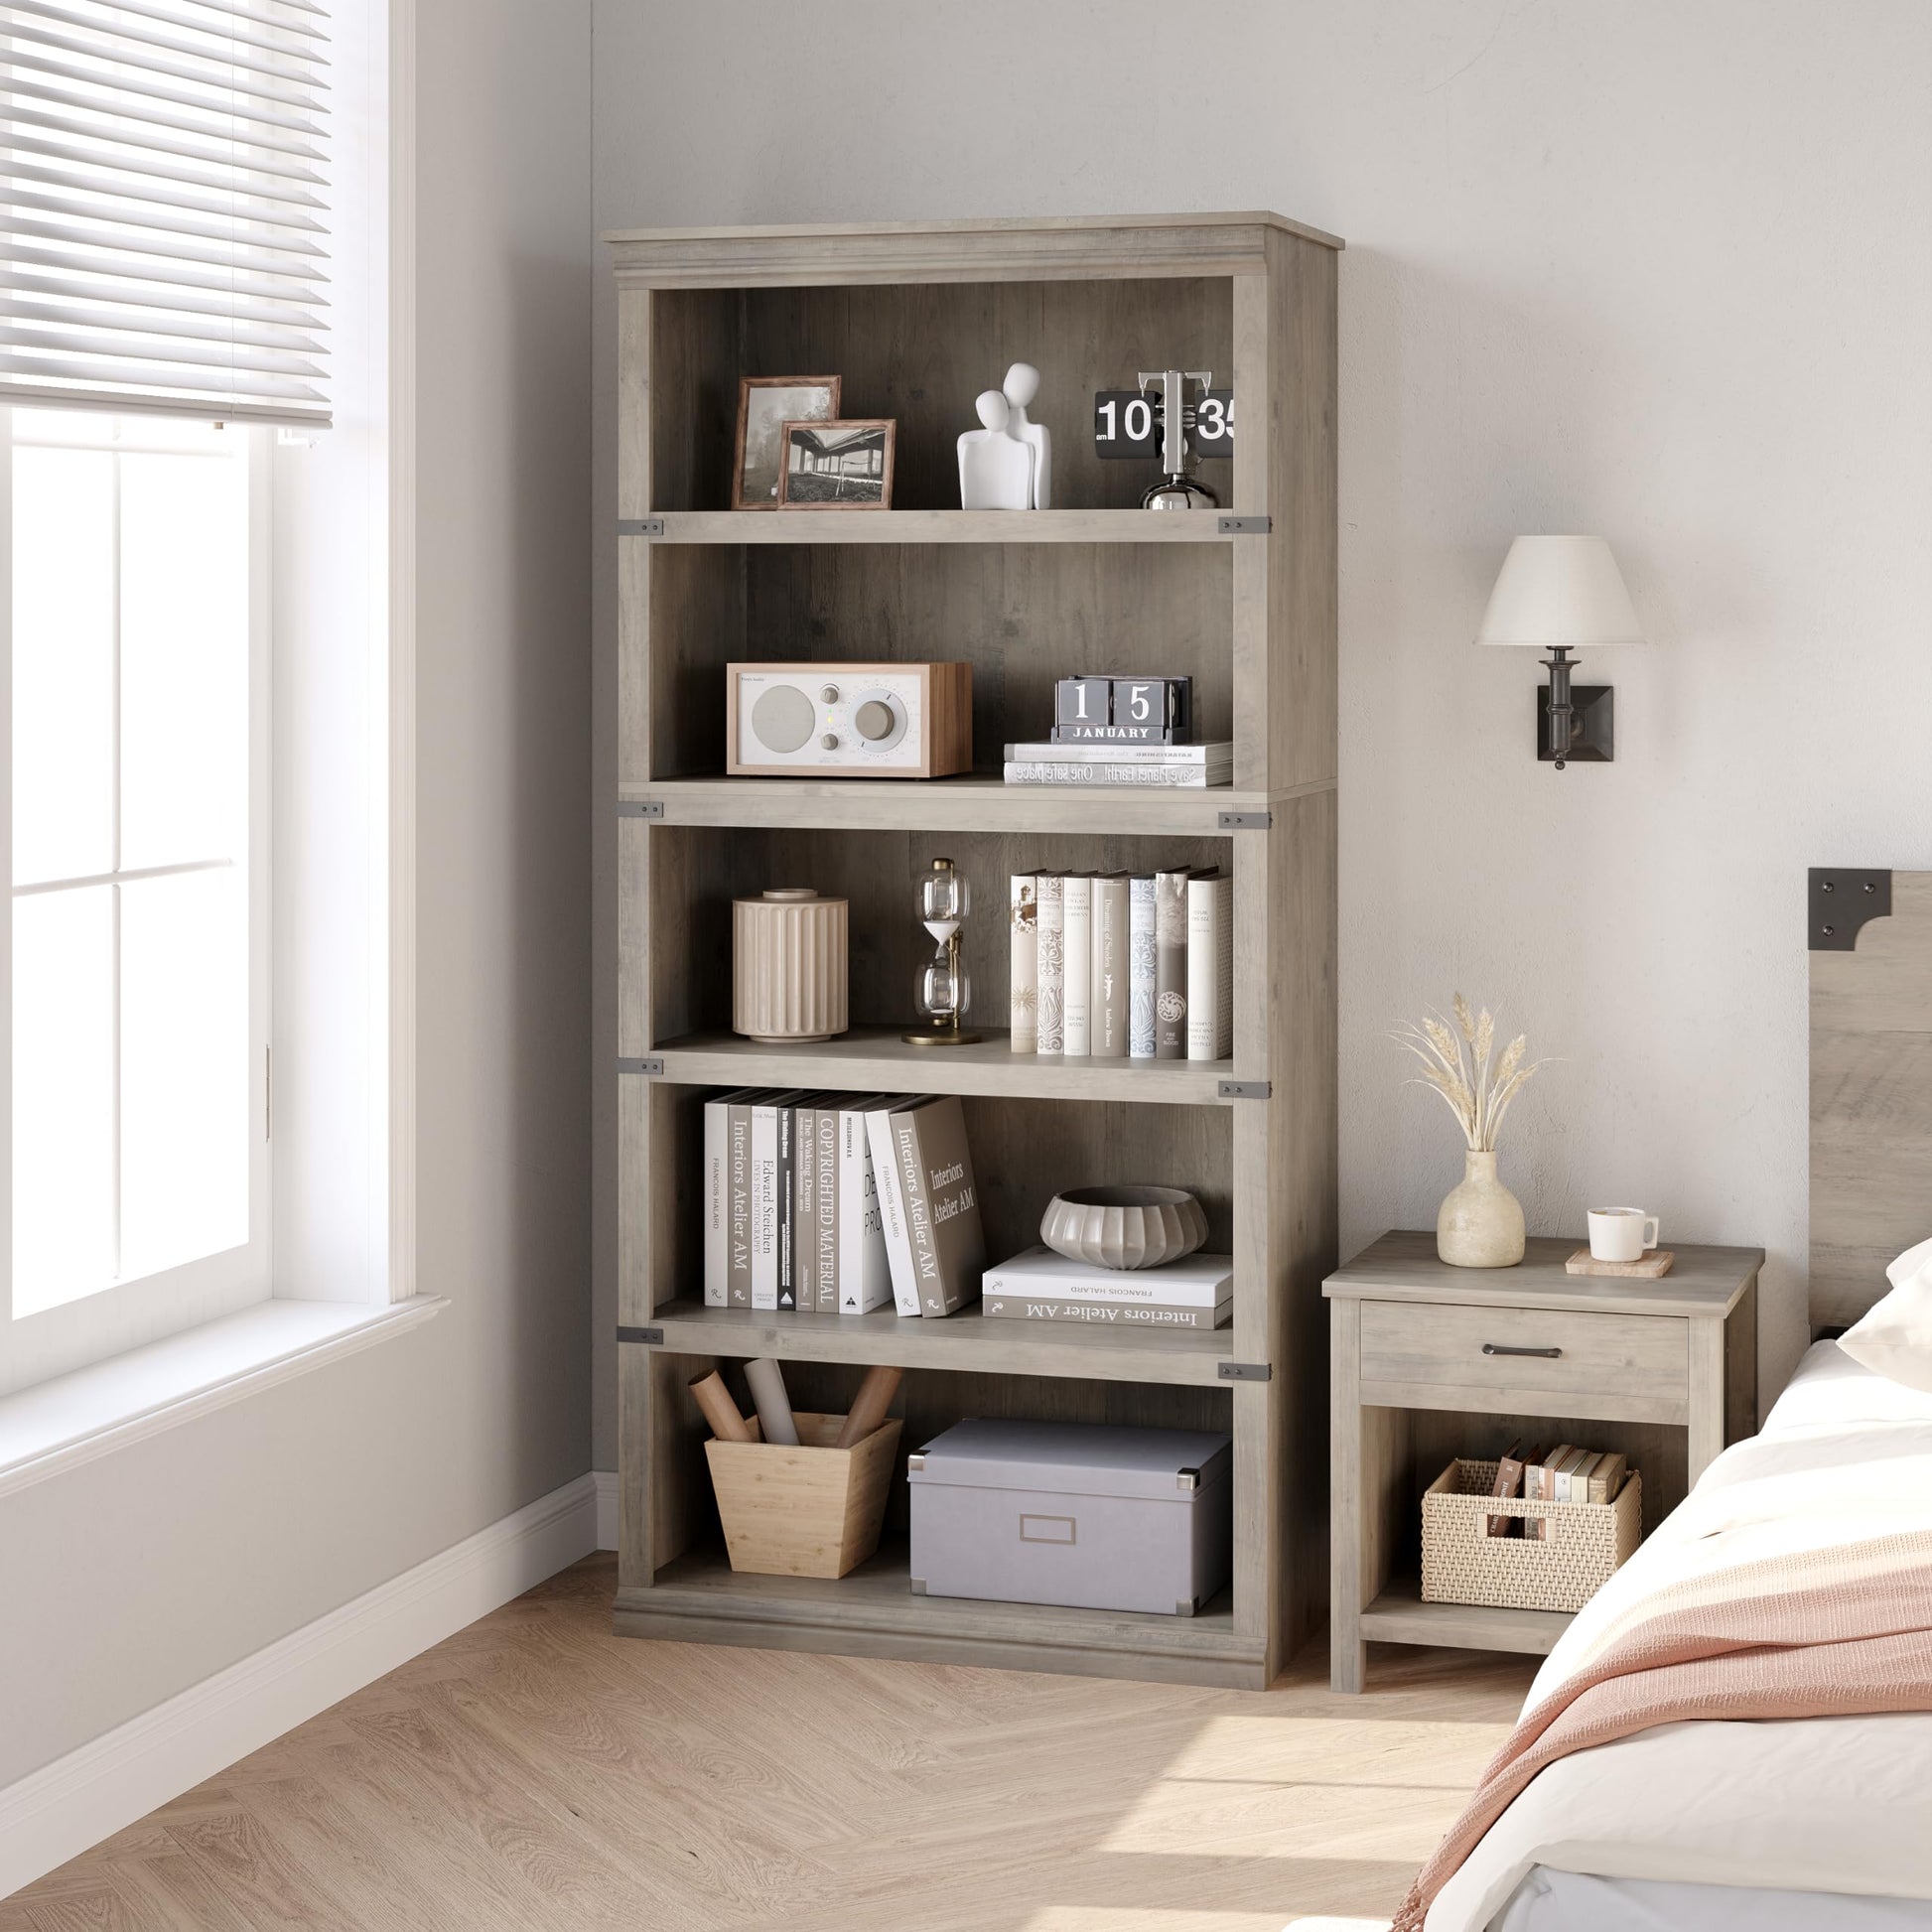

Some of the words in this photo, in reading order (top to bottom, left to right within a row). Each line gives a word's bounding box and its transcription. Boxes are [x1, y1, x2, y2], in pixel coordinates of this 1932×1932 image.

[1098, 399, 1152, 440] 10
[1198, 398, 1234, 440] 3
[1075, 683, 1089, 719] 1
[1130, 686, 1150, 721] 5
[1072, 727, 1150, 739] JANUARY
[804, 1116, 813, 1136] The
[734, 1120, 748, 1183] Interiors
[803, 1139, 813, 1176] Waking
[763, 1160, 774, 1202] Edward
[820, 1117, 834, 1225] COPYRIGHTED
[930, 1162, 964, 1190] Interiors
[734, 1188, 748, 1237] Atelier
[804, 1179, 813, 1212] Dream
[898, 1128, 918, 1192] Interiors
[910, 1197, 928, 1245] Atelier
[919, 1249, 936, 1279] AM
[934, 1196, 959, 1225] Atelier
[960, 1187, 974, 1212] AM
[763, 1204, 774, 1254] Steichen
[888, 1207, 899, 1238] HALARD
[734, 1241, 747, 1270] AM
[820, 1229, 834, 1303] MATERIAL
[1070, 1286, 1106, 1295] HALARD
[1026, 1304, 1058, 1317] AM
[1063, 1306, 1118, 1321] Atelier
[1124, 1310, 1198, 1326] Interiors
